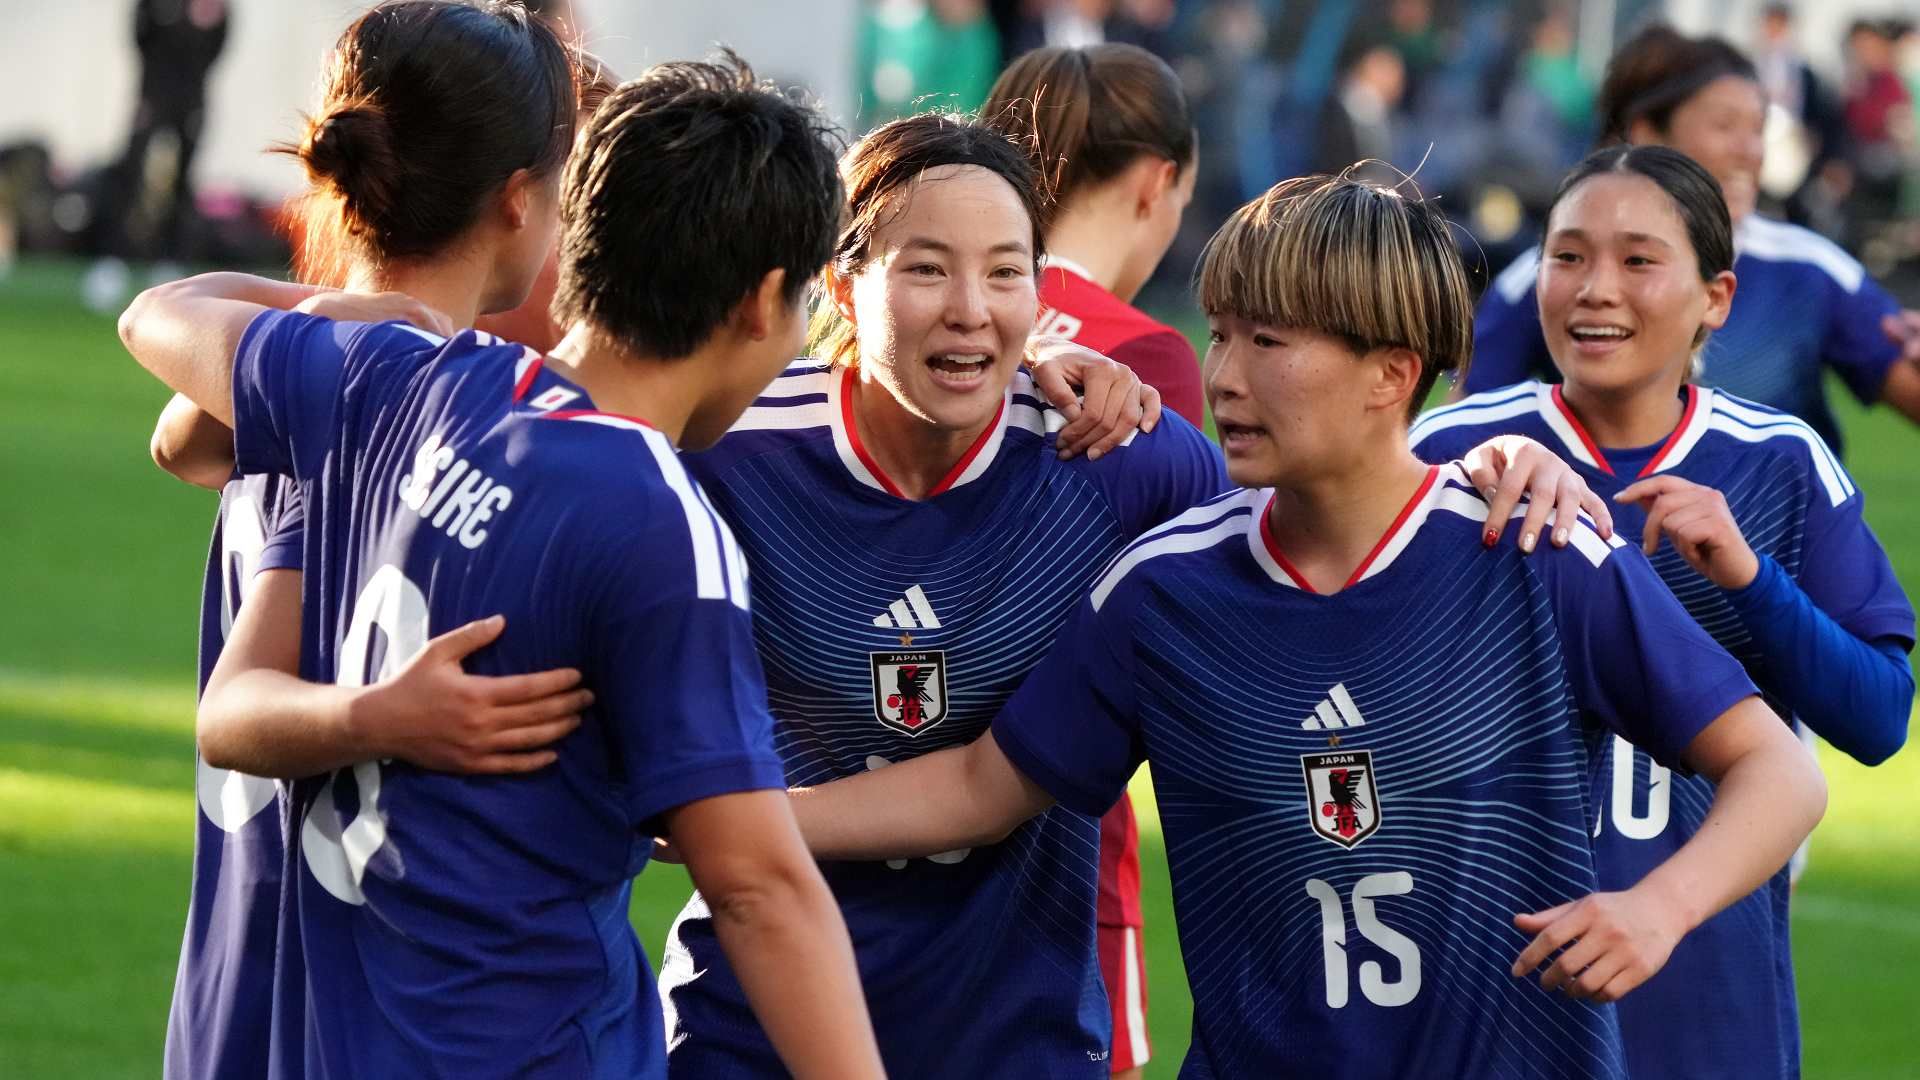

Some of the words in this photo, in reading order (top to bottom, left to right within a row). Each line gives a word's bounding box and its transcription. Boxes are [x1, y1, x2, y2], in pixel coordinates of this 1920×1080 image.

[398, 434, 513, 549] SEIKE
[889, 654, 927, 662] JAPAN
[896, 706, 928, 721] JFA
[1320, 755, 1356, 765] JAPAN
[1331, 815, 1364, 831] JFA
[1305, 871, 1422, 1009] 15
